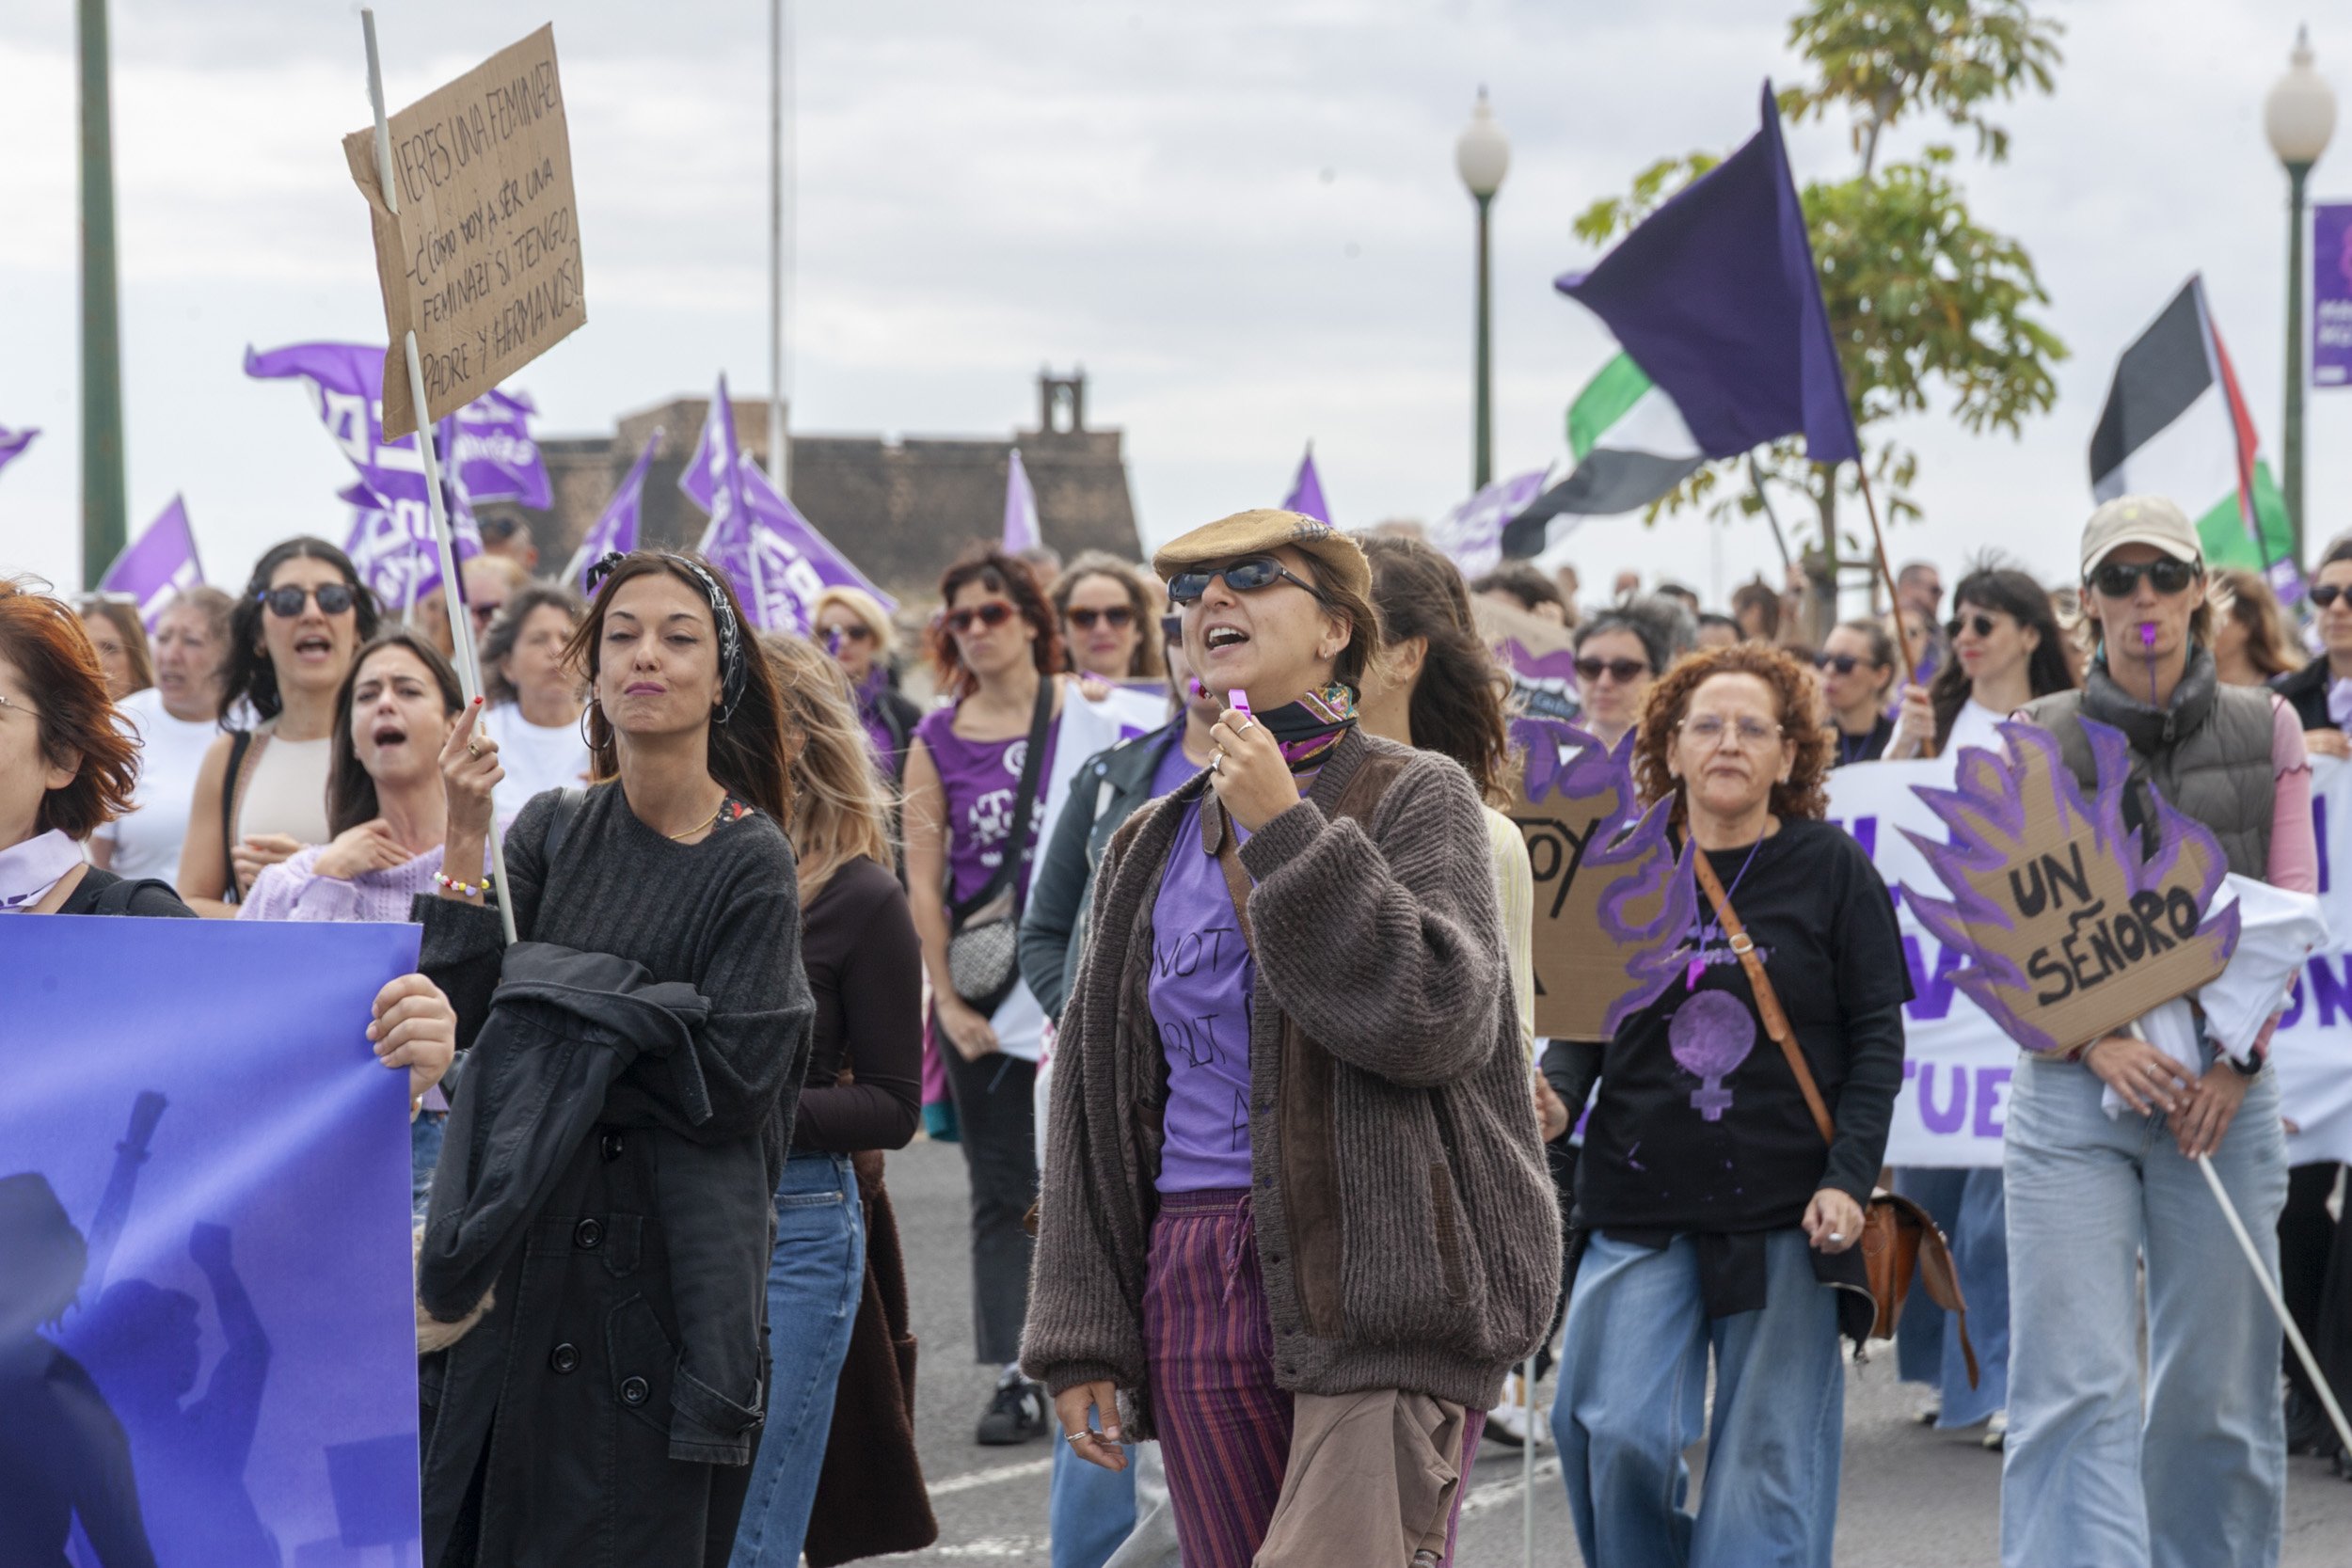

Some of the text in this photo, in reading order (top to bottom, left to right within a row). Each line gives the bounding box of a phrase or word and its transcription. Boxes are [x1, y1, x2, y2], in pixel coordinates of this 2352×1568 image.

[449, 103, 490, 167] UNA
[487, 200, 499, 232] A
[499, 179, 524, 221] SER
[525, 157, 554, 201] UNA
[496, 248, 511, 286] SI
[514, 207, 568, 272] TENGO
[422, 343, 470, 403] PADRE
[476, 325, 488, 374] Y
[2009, 841, 2092, 918] UN
[1151, 927, 1235, 987] NOT
[2027, 885, 2199, 1006] SEÑORO
